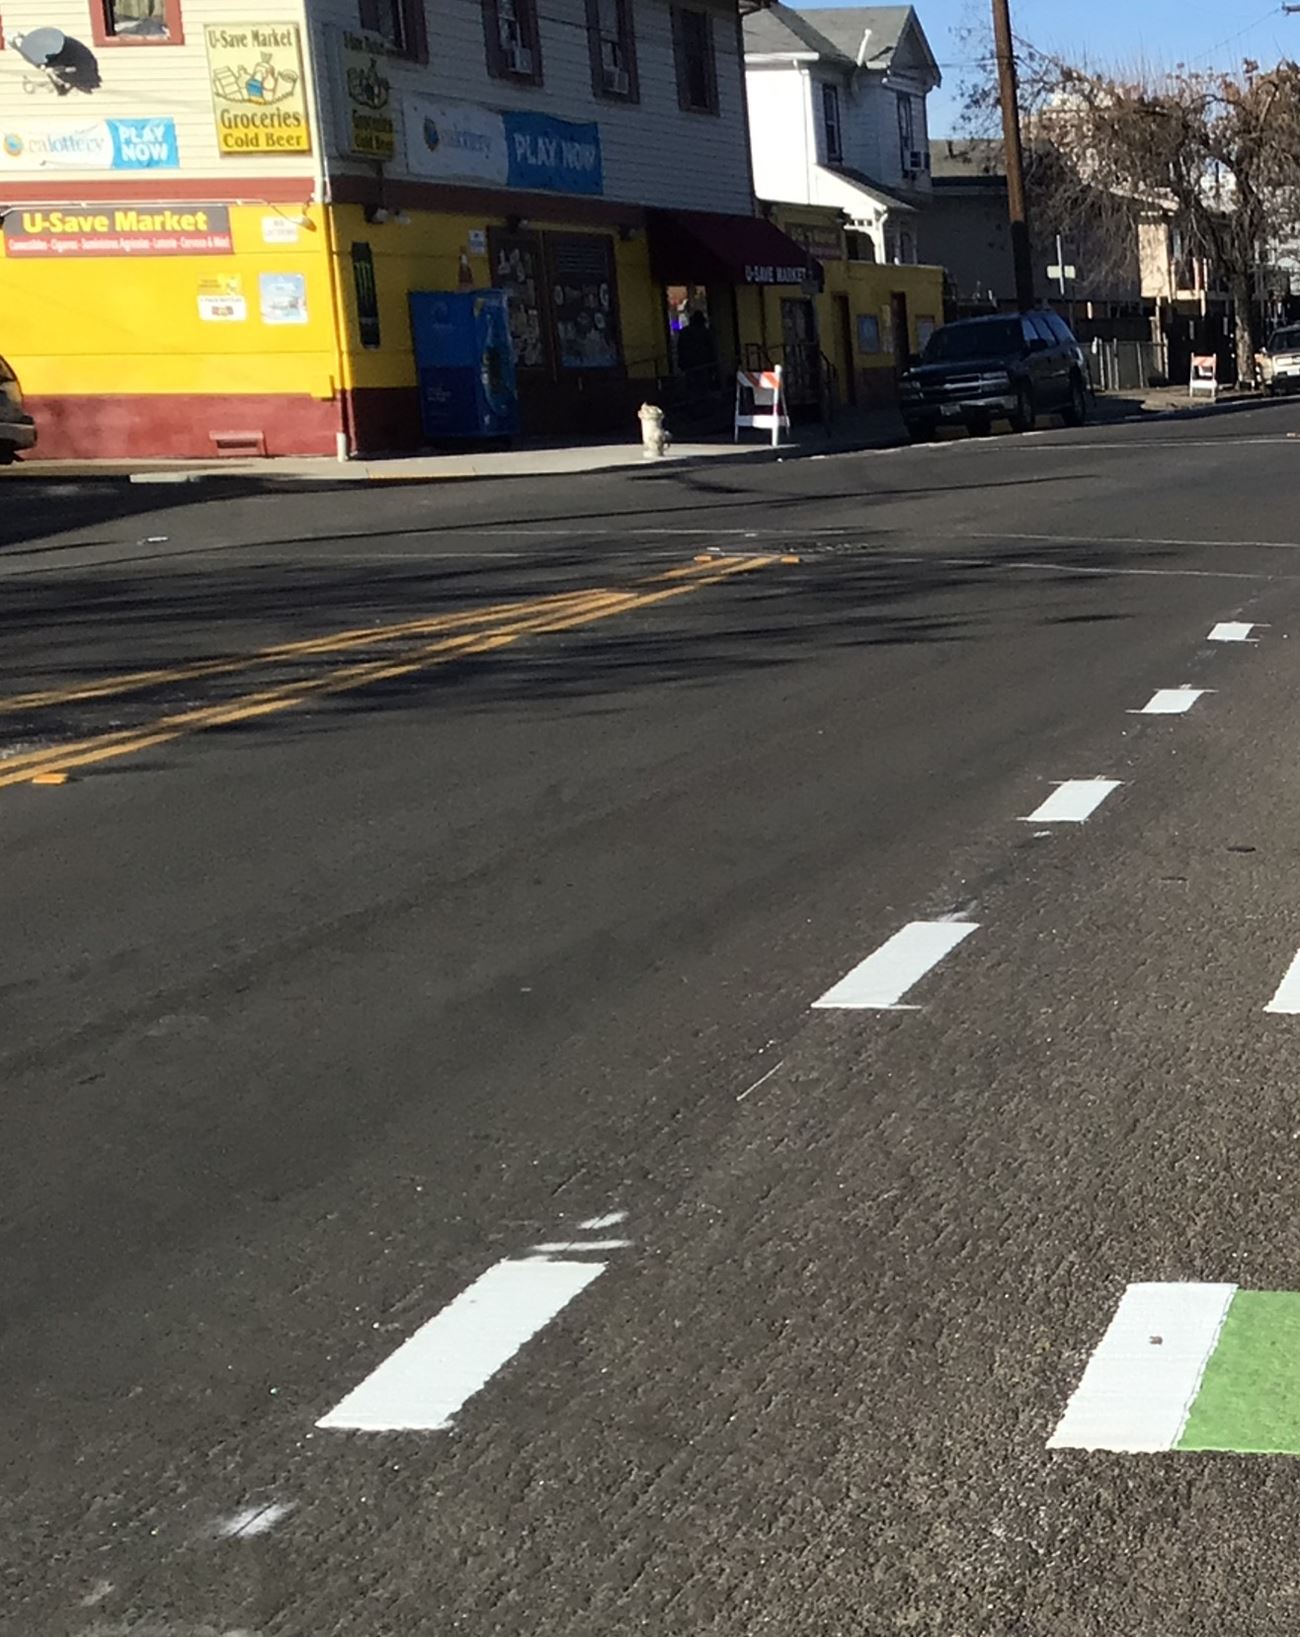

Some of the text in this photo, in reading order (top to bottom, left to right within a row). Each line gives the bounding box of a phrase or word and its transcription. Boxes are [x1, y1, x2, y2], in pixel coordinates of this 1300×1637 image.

[207, 28, 292, 49] U-Save Market
[220, 107, 302, 129] Groceries
[119, 124, 166, 143] PLAY
[223, 131, 303, 149] Cold Beer
[122, 142, 169, 162] NOW
[513, 132, 557, 167] PLAY
[22, 209, 208, 234] U-Save Market
